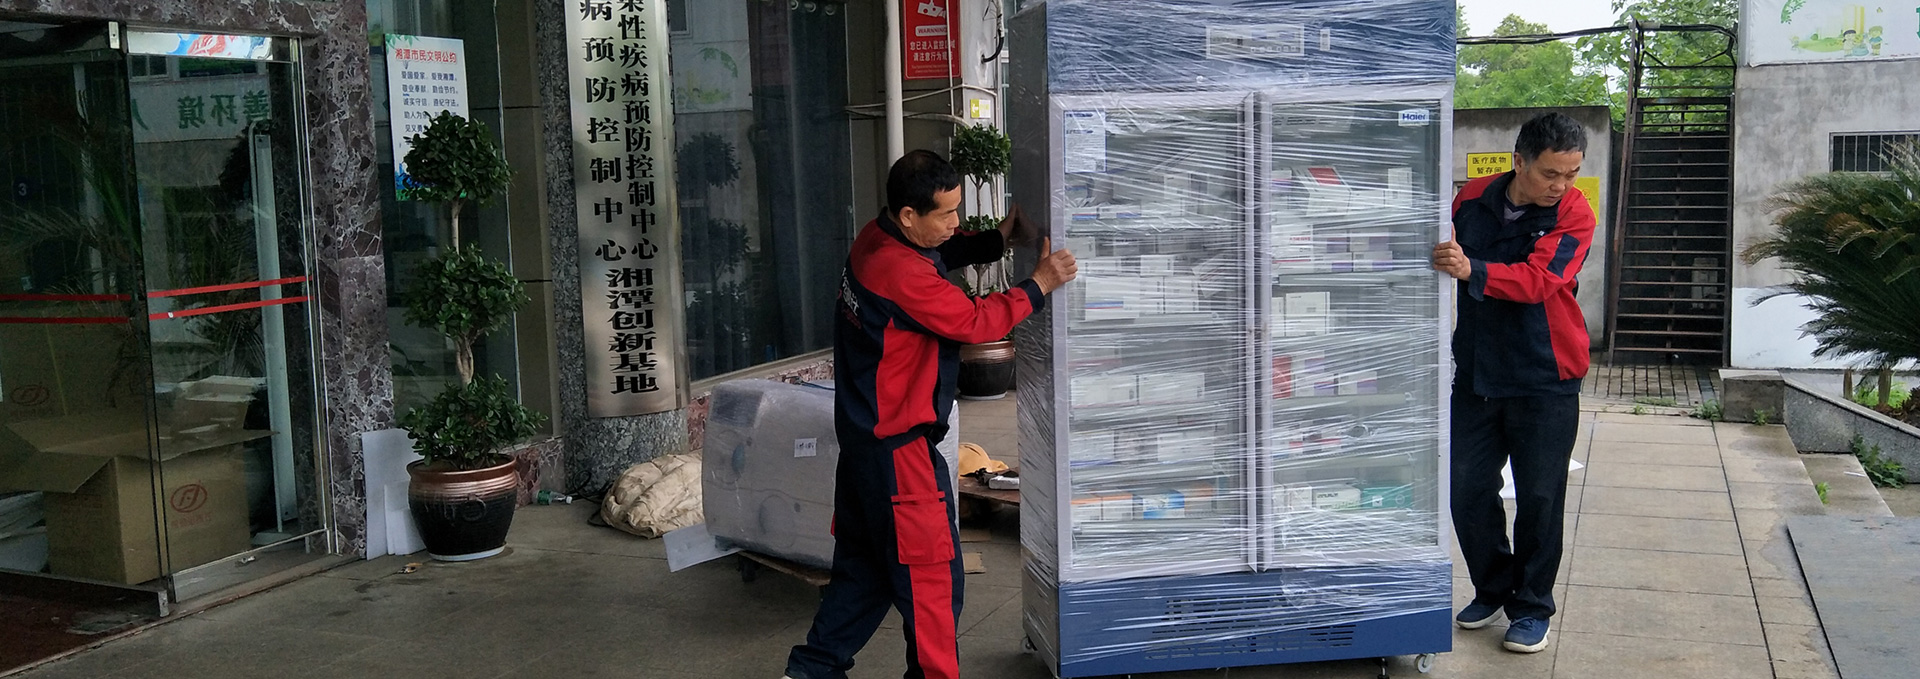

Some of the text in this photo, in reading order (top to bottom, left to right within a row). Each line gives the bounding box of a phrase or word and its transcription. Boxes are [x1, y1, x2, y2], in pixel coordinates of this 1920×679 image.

[395, 48, 457, 62] 湘潭市民文明公约
[1472, 156, 1507, 165] 医疗废物
[605, 268, 660, 394] 湘潭创新基地
